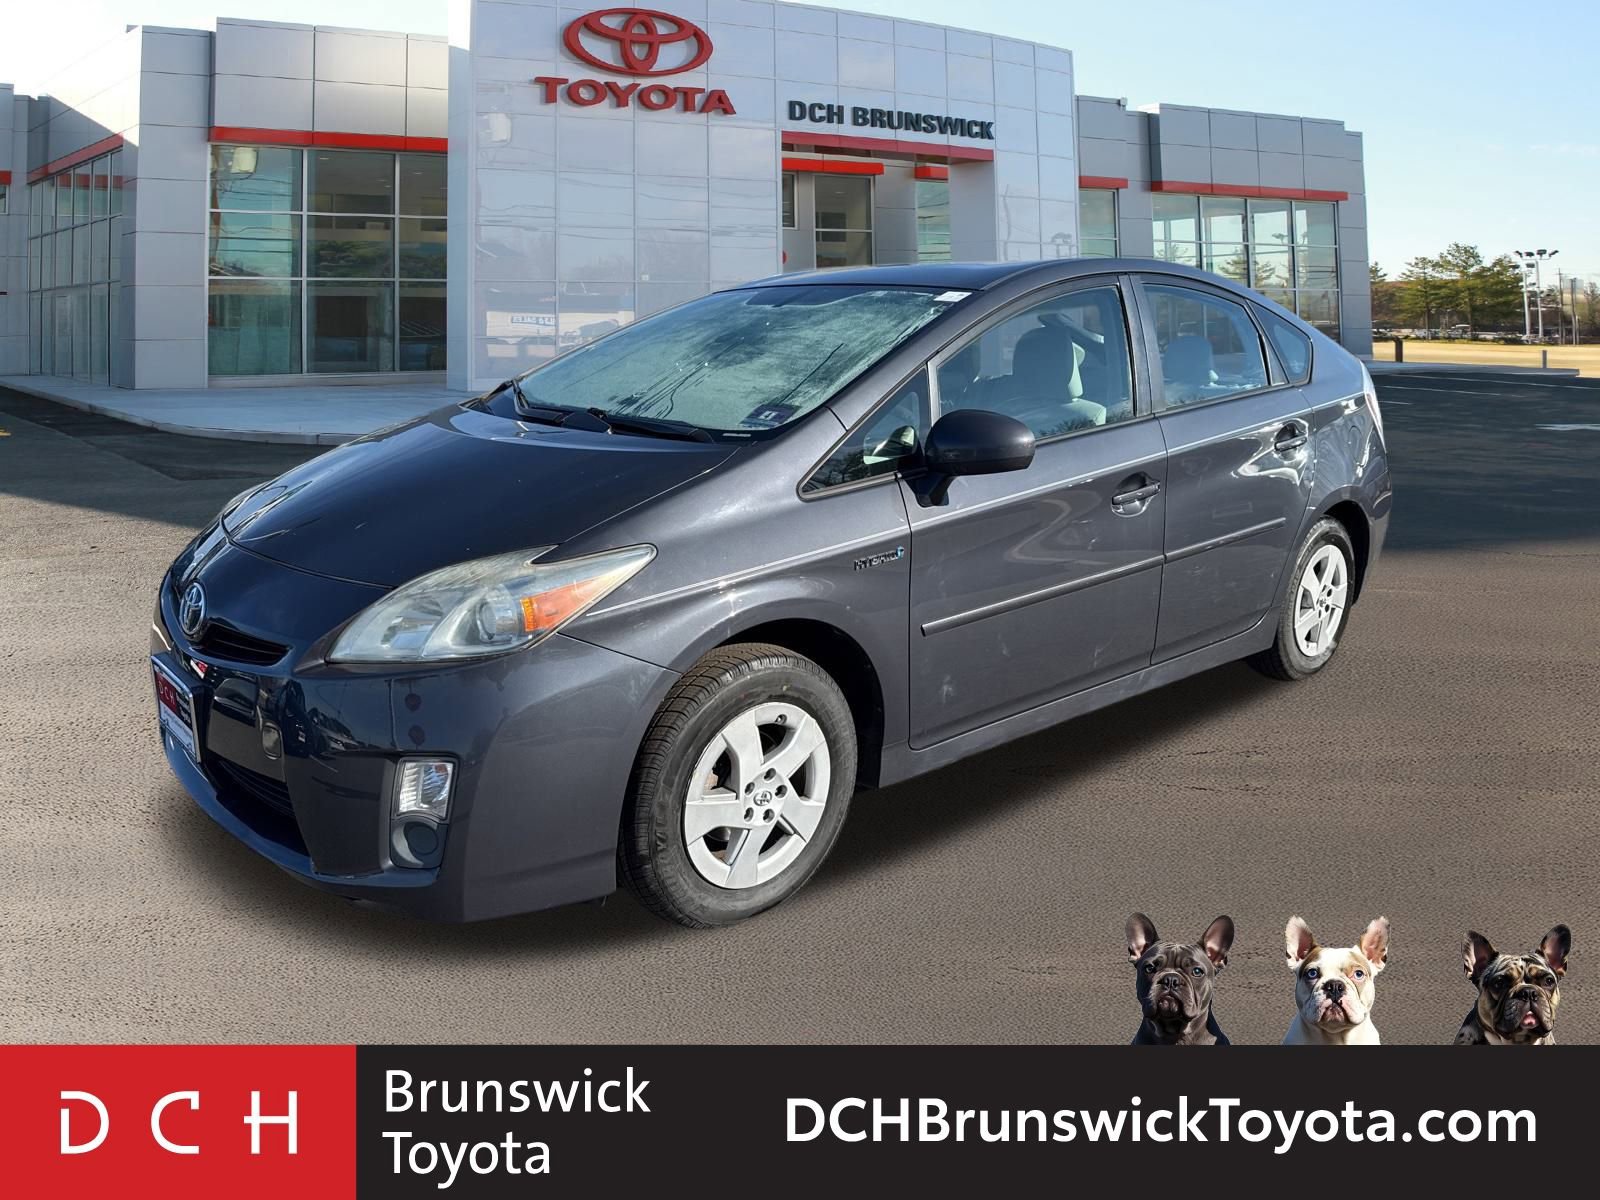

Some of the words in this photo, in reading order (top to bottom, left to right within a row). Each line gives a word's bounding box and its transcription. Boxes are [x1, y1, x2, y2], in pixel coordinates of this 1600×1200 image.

[535, 76, 736, 115] TOYOTA
[788, 100, 845, 126] DCH
[851, 107, 995, 140] BRUNSWICK
